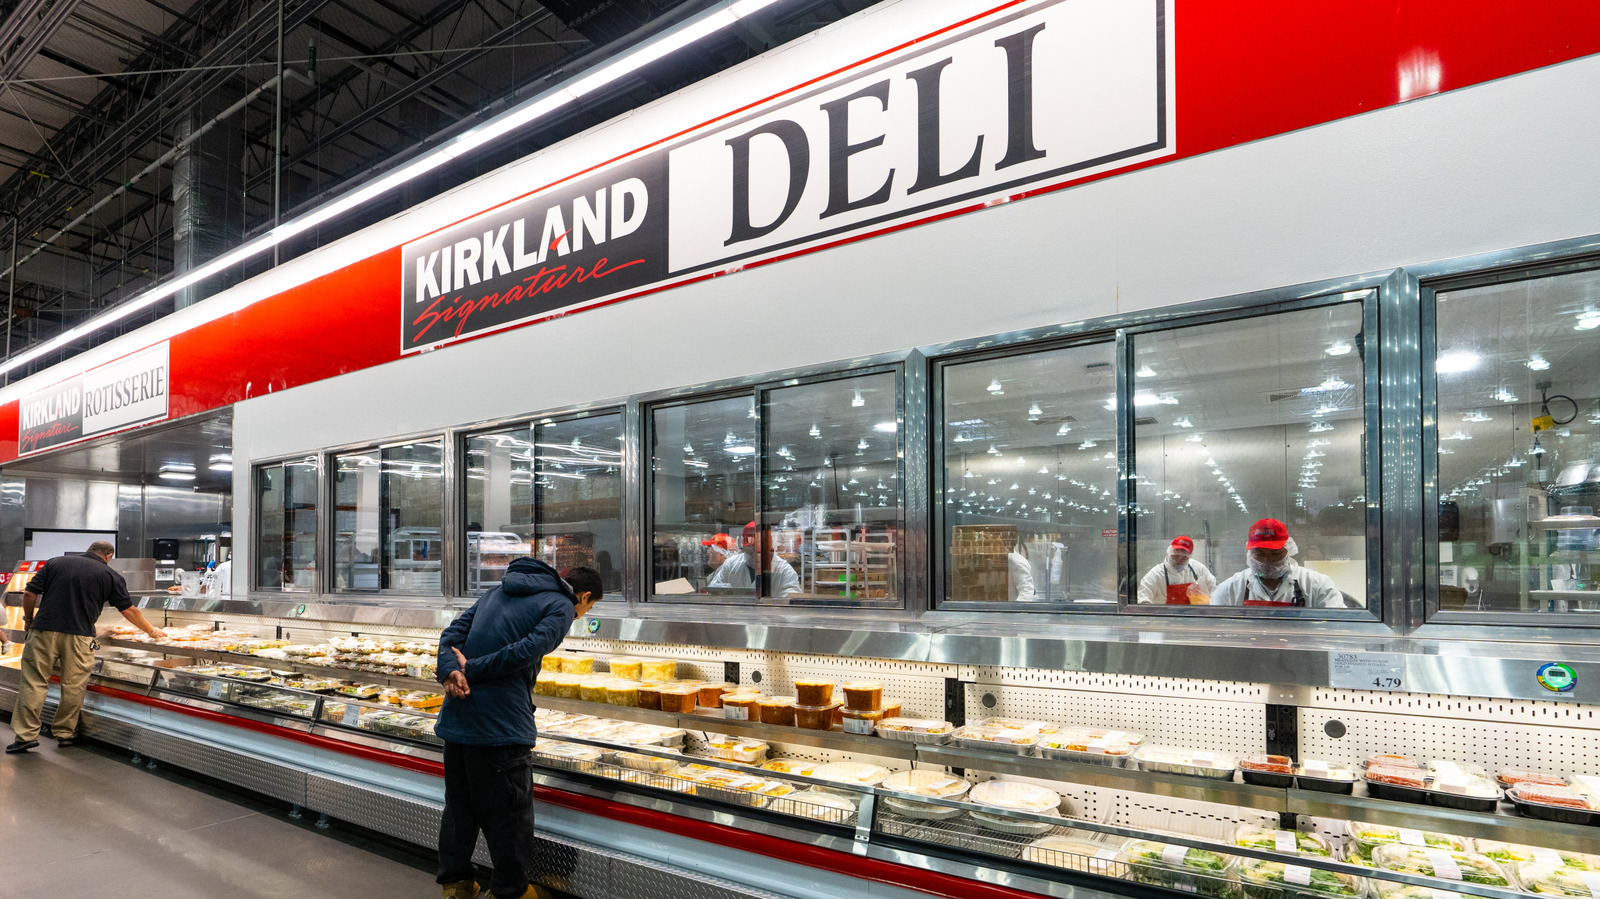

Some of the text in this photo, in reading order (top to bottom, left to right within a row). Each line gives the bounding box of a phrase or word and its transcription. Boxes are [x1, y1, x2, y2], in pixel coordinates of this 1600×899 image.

[724, 22, 1047, 247] DELI
[416, 177, 649, 303] KIRKLAND
[412, 257, 645, 342] Signature
[22, 386, 81, 431] KIRKLAND
[84, 365, 165, 418] ROTISSERIE
[21, 422, 79, 451] Signature
[1372, 677, 1402, 688] 4.79
